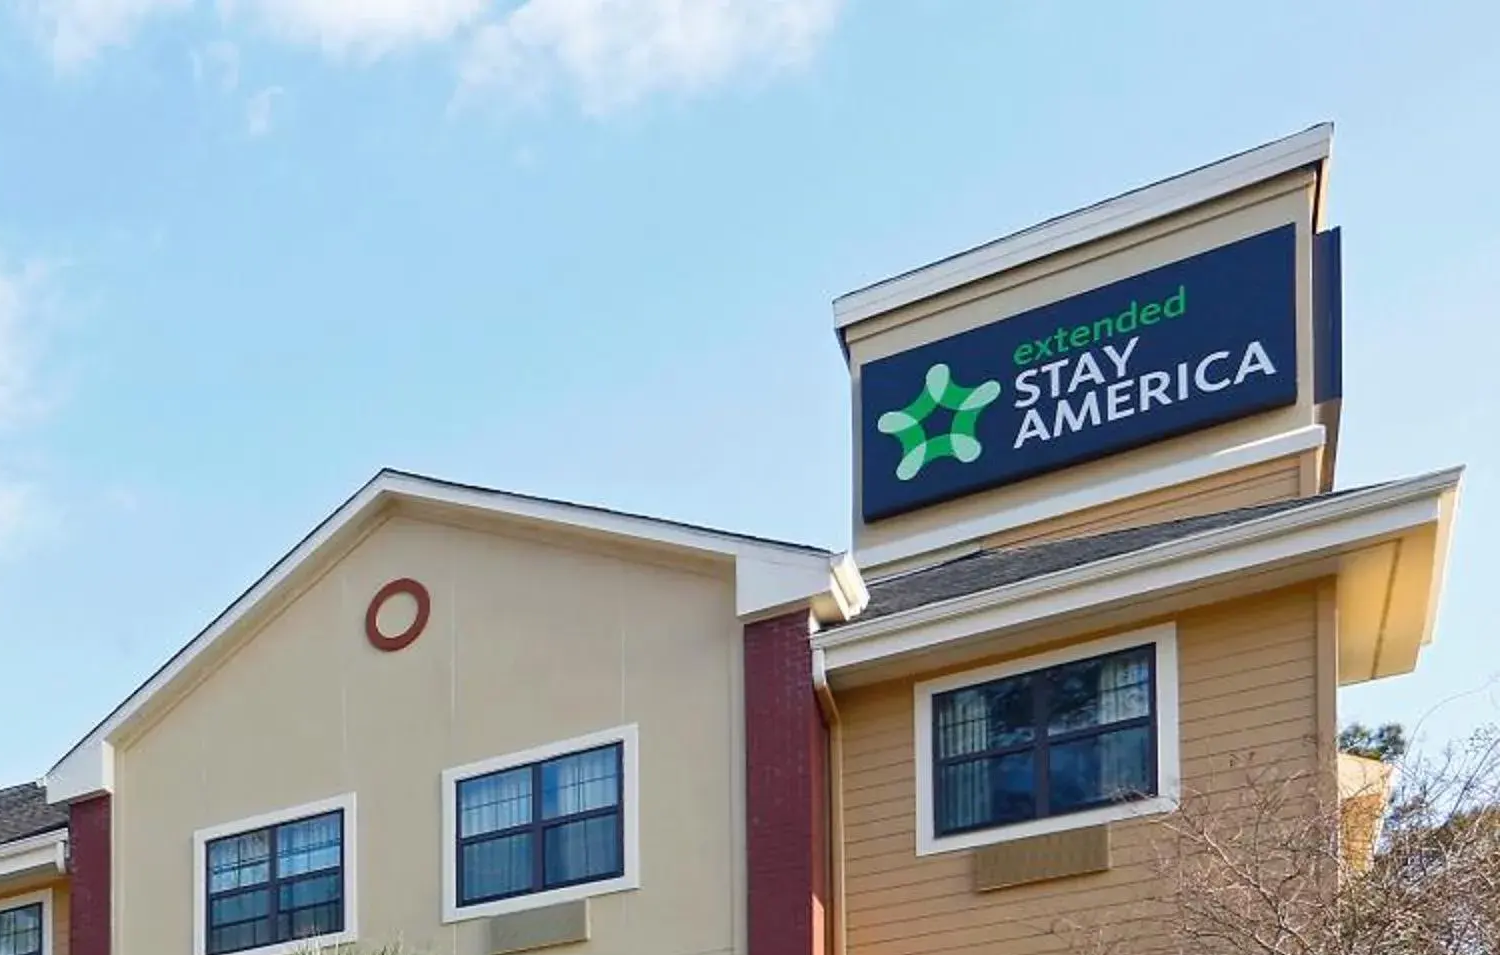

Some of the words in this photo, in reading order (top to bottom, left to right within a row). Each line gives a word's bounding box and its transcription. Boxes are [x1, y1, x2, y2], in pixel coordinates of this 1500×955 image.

[1013, 285, 1186, 366] extended
[1013, 341, 1277, 449] AMERICA
[1015, 336, 1140, 408] STAY
